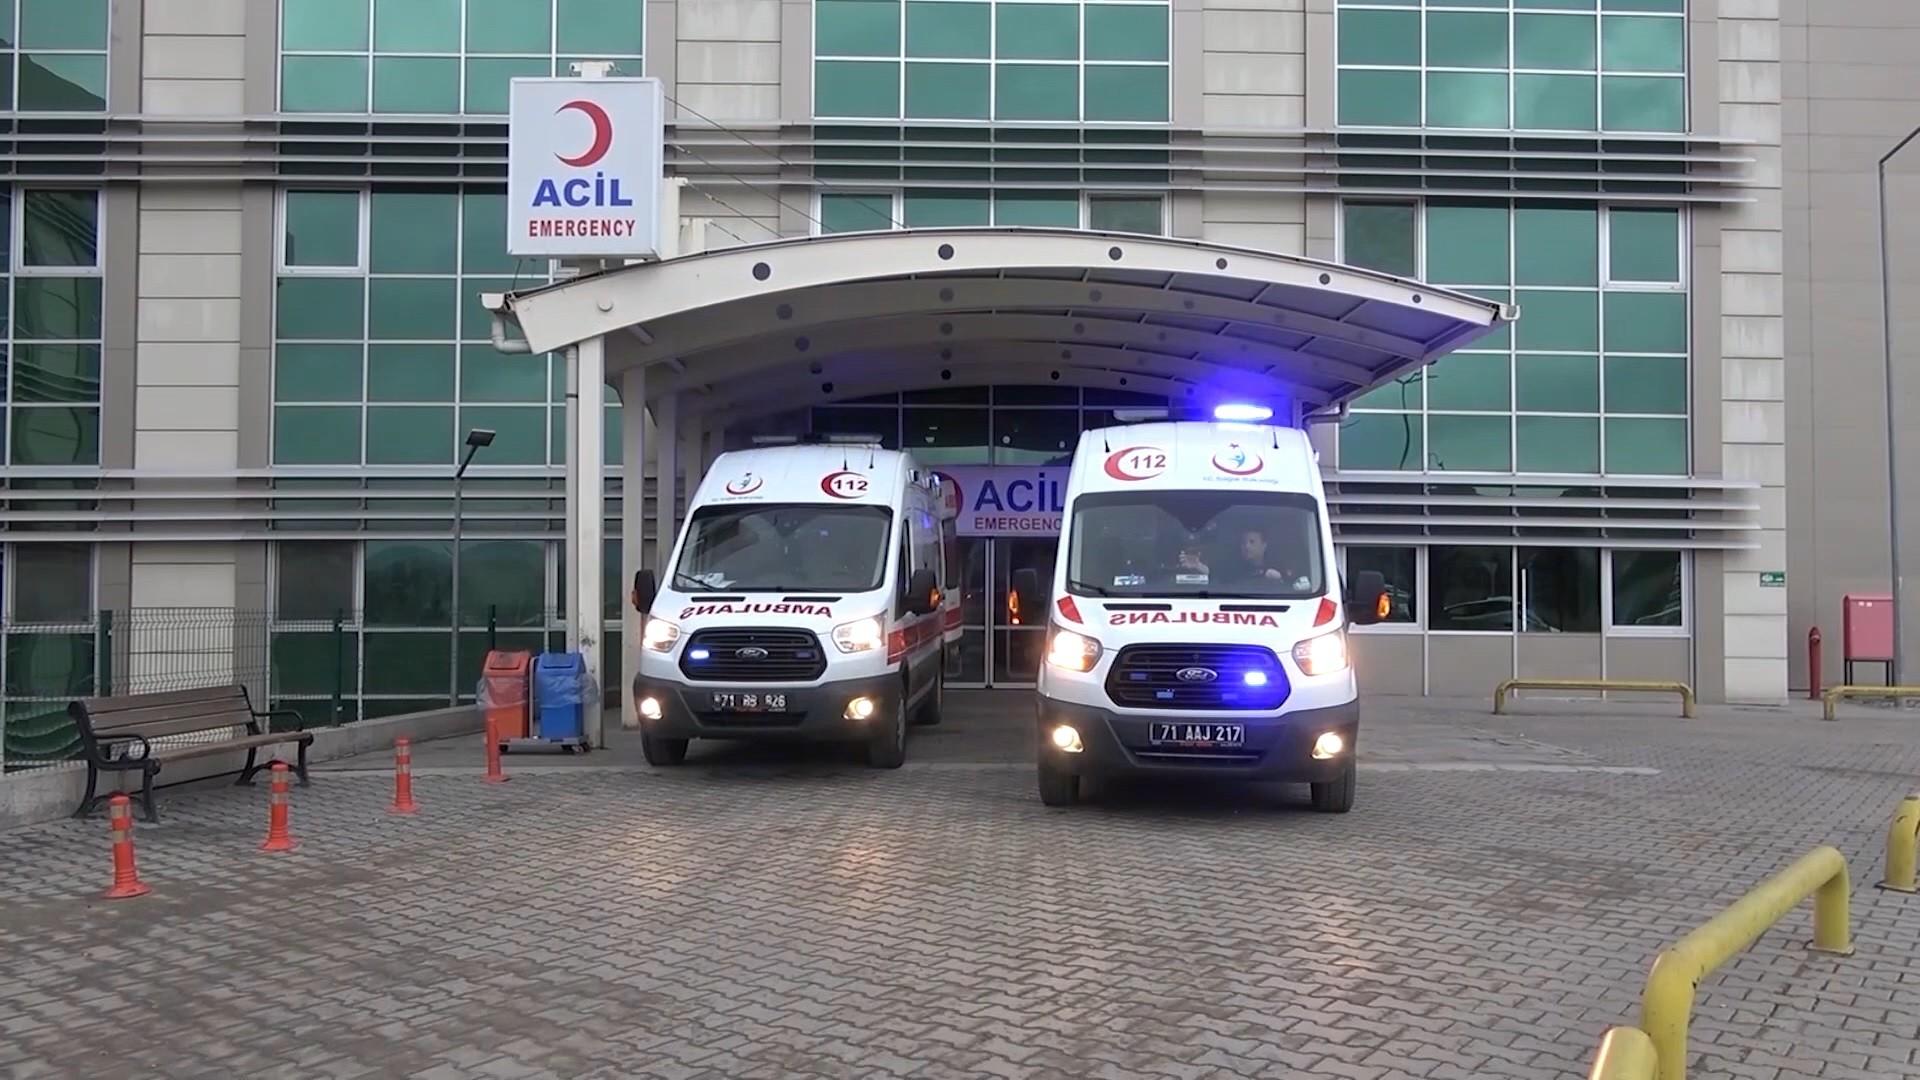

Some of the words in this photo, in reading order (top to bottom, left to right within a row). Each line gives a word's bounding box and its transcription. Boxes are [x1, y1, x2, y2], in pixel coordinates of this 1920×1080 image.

[532, 171, 633, 207] ACİL
[529, 219, 636, 237] EMERGENCY
[1131, 454, 1167, 470] 112
[833, 479, 869, 491] 112
[973, 472, 1065, 512] ACİL
[975, 516, 1063, 531] EMERGENC
[721, 694, 736, 707] 71
[1161, 725, 1177, 740] 71
[1185, 725, 1211, 741] AAJ
[1216, 726, 1241, 741] 217
